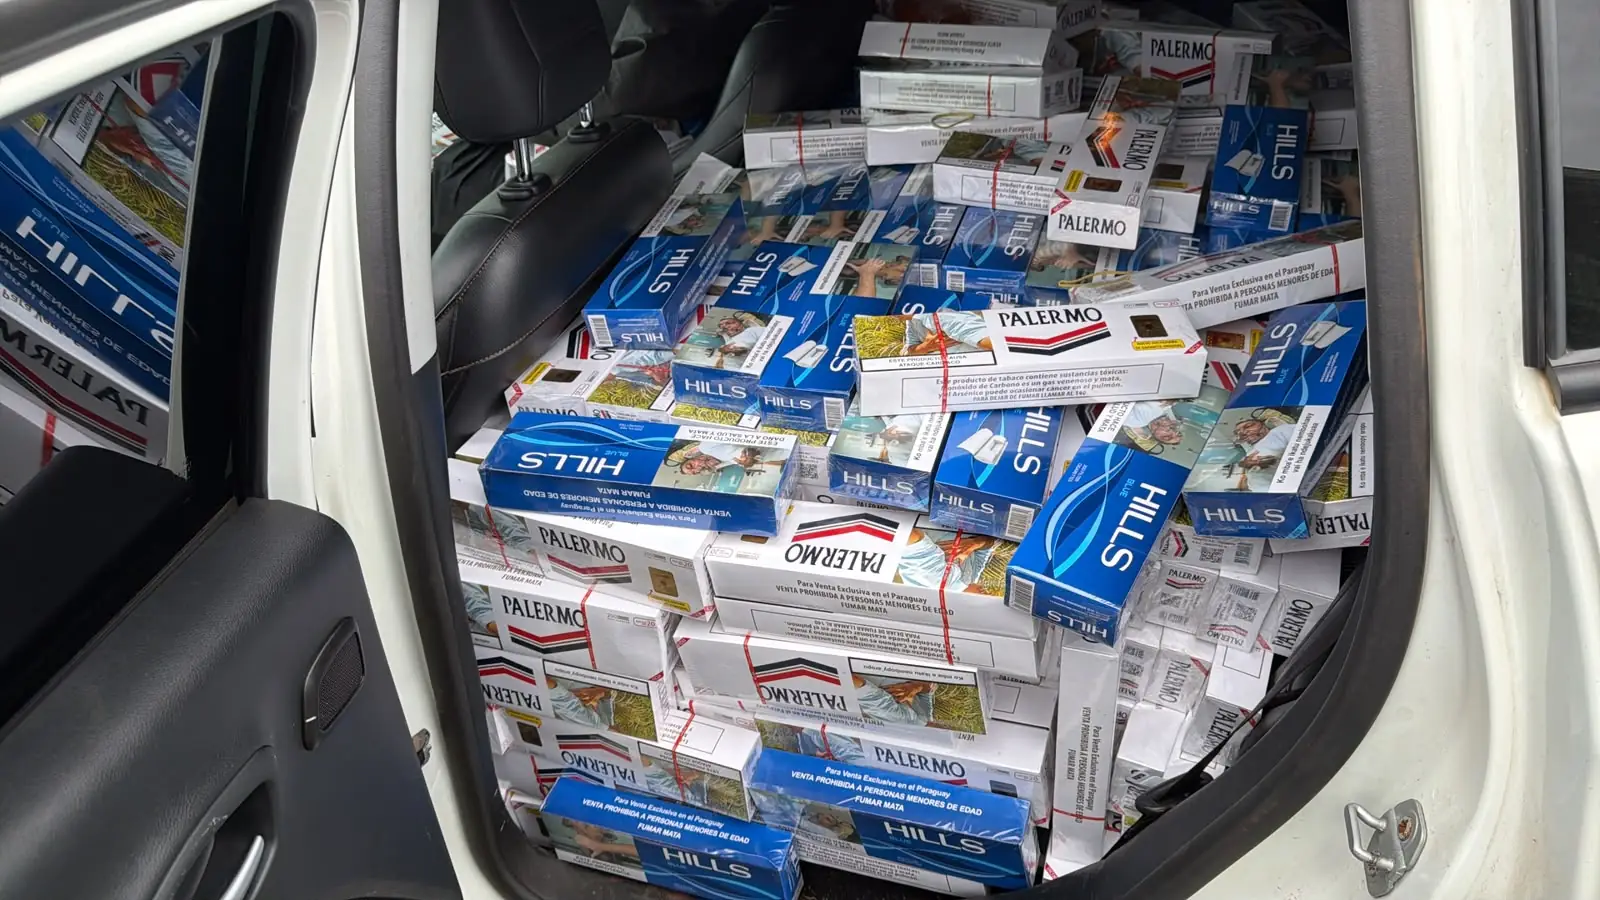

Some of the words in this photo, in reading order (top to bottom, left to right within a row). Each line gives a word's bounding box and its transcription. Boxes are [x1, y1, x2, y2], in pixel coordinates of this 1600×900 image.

[1150, 39, 1216, 61] PALERMO
[1123, 129, 1158, 170] PALERMO
[1272, 124, 1299, 180] HILLS
[832, 167, 867, 201] HILLS
[922, 206, 957, 246] HILLS
[1004, 214, 1037, 257] HILLS
[1058, 213, 1126, 236] PALERMO
[648, 248, 695, 294] HILLS
[732, 252, 777, 295] HILLS
[1192, 289, 1208, 298] Para
[1209, 284, 1230, 294] Venta
[1232, 276, 1263, 289] Exclusiva
[1275, 270, 1281, 278] el
[1283, 263, 1315, 277] Paraguay
[1194, 293, 1233, 309] PROHIBIDA
[1234, 291, 1239, 299] A
[1240, 282, 1275, 297] PERSONAS
[1277, 275, 1309, 288] MENORES
[1311, 271, 1320, 280] DE
[1321, 268, 1337, 278] EDA
[1234, 297, 1260, 310] FUMAR
[1260, 292, 1279, 304] MATA
[998, 307, 1103, 328] PALERMO
[621, 332, 665, 343] HILLS
[830, 323, 857, 373] LLS
[1245, 322, 1298, 387] HILLS
[684, 379, 747, 400] HILLS
[985, 389, 1008, 397] puede
[1009, 386, 1045, 395] ocasionar
[1018, 392, 1039, 400] FUMAR
[764, 396, 812, 410] HILLS
[1013, 406, 1051, 475] HILLS
[517, 451, 625, 476] HILLS
[524, 489, 547, 497] EDAD
[546, 491, 558, 499] DE
[596, 486, 619, 495] MATA
[620, 489, 650, 498] FUMAR
[843, 470, 914, 496] HILLS
[1119, 477, 1135, 498] BLUE
[559, 492, 600, 503] MENORES
[560, 501, 595, 511] Paraguay
[601, 497, 647, 508] PERSONAS
[655, 502, 701, 514] PROHIBIDA
[939, 492, 995, 514] HILLS
[616, 508, 653, 518] Exclusiva
[654, 512, 677, 520] Venta
[677, 515, 696, 523] Para
[702, 508, 731, 517] VENTA
[1203, 507, 1286, 523] HILLS
[1315, 512, 1370, 534] PALER
[1100, 482, 1168, 572] HILLS
[538, 525, 626, 564] PALERMO
[785, 543, 886, 574] PALERMO
[501, 574, 525, 583] FUMAR
[525, 578, 543, 586] MATA
[1167, 568, 1206, 583] PALERMO
[776, 585, 798, 594] VENTA
[799, 587, 839, 600] PROHIBIDA
[847, 594, 884, 606] PERSONAS
[885, 600, 921, 611] MENORES
[923, 605, 933, 613] DE
[797, 579, 813, 588] Para
[814, 582, 836, 591] Venta
[837, 585, 870, 596] Exclusiva
[891, 593, 927, 605] Paraguay
[501, 594, 585, 628] PALERMO
[840, 602, 867, 612] FUMAR
[868, 605, 888, 614] MATA
[1047, 609, 1108, 639] HILLS
[1271, 598, 1314, 651] PALERMO
[1159, 659, 1192, 704] PALERMO
[481, 684, 542, 711] PALERM
[760, 685, 848, 711] PALERMO
[561, 750, 637, 783] PALERMO
[874, 745, 966, 778] PALERMO
[1067, 748, 1075, 767] FUMAR
[825, 766, 842, 776] Para
[843, 770, 862, 780] Venta
[863, 774, 896, 788] Exclusiva
[908, 782, 916, 791] el
[917, 784, 951, 799] Paraguay
[1066, 767, 1074, 780] MATA
[791, 770, 815, 782] VENTA
[815, 775, 855, 790] PROHIBIDA
[855, 785, 863, 793] A
[864, 786, 905, 801] PERSONAS
[907, 793, 946, 808] MENORES
[947, 802, 959, 810] DE
[960, 804, 982, 816] EDAD
[854, 795, 883, 808] FUMAR
[884, 801, 904, 812] MATA
[582, 798, 604, 809] VENTA
[604, 804, 640, 819] PROHIBIDA
[646, 814, 684, 829] PERSONAS
[684, 823, 718, 836] MENORES
[719, 831, 729, 839] DE
[730, 833, 750, 844] EDAD
[614, 796, 628, 805] Para
[629, 799, 647, 810] Venta
[648, 804, 677, 818] Exclusiva
[688, 812, 694, 821] el
[694, 814, 724, 829] Paraguay
[637, 823, 662, 835] FUMAR
[663, 829, 681, 840] MATA
[883, 821, 987, 855] HILLS
[662, 847, 752, 879] HILLS
